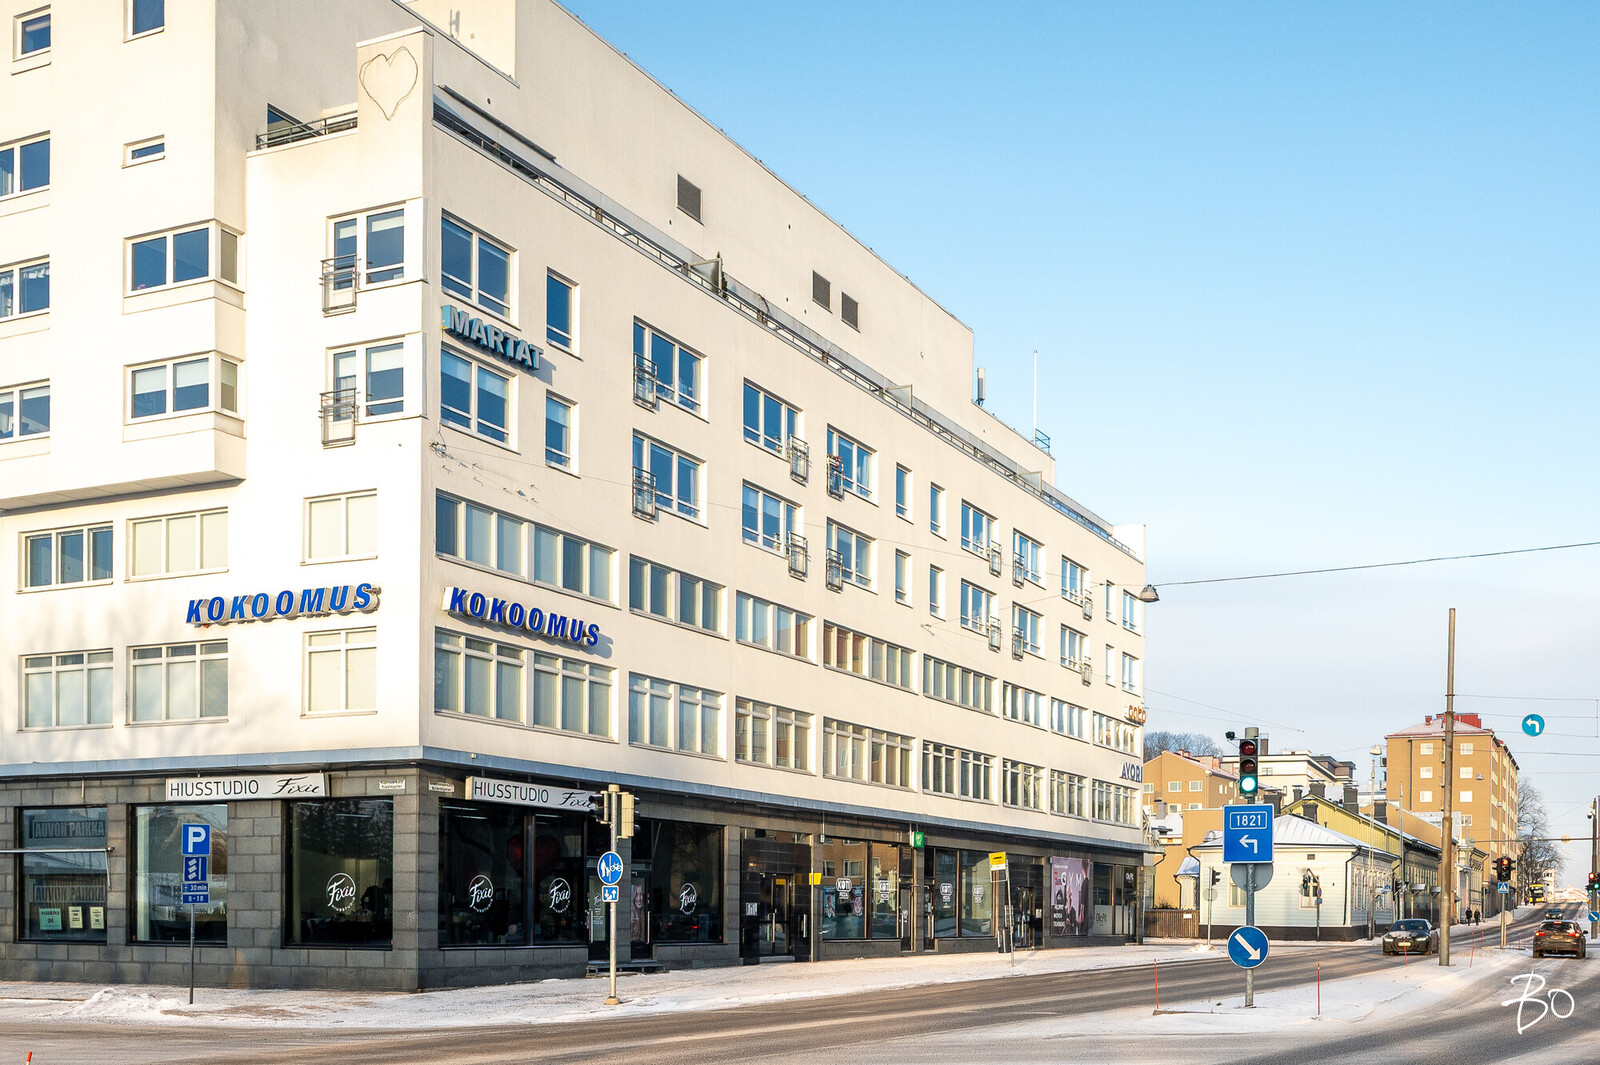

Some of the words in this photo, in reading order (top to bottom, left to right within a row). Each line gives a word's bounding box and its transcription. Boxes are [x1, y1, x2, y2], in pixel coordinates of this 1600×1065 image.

[449, 305, 543, 370] MARTAT
[186, 582, 374, 624] KOKOOMUS
[449, 586, 601, 647] KOKOOMUS
[170, 779, 259, 797] HIUSSTUDIO
[272, 776, 320, 795] Fixie
[474, 780, 549, 804] HIUSSTUDIO
[1236, 814, 1261, 827] 1821
[188, 826, 206, 853] P
[327, 878, 354, 906] Fixie
[469, 880, 492, 908] Fixie
[549, 882, 570, 909] Fixie
